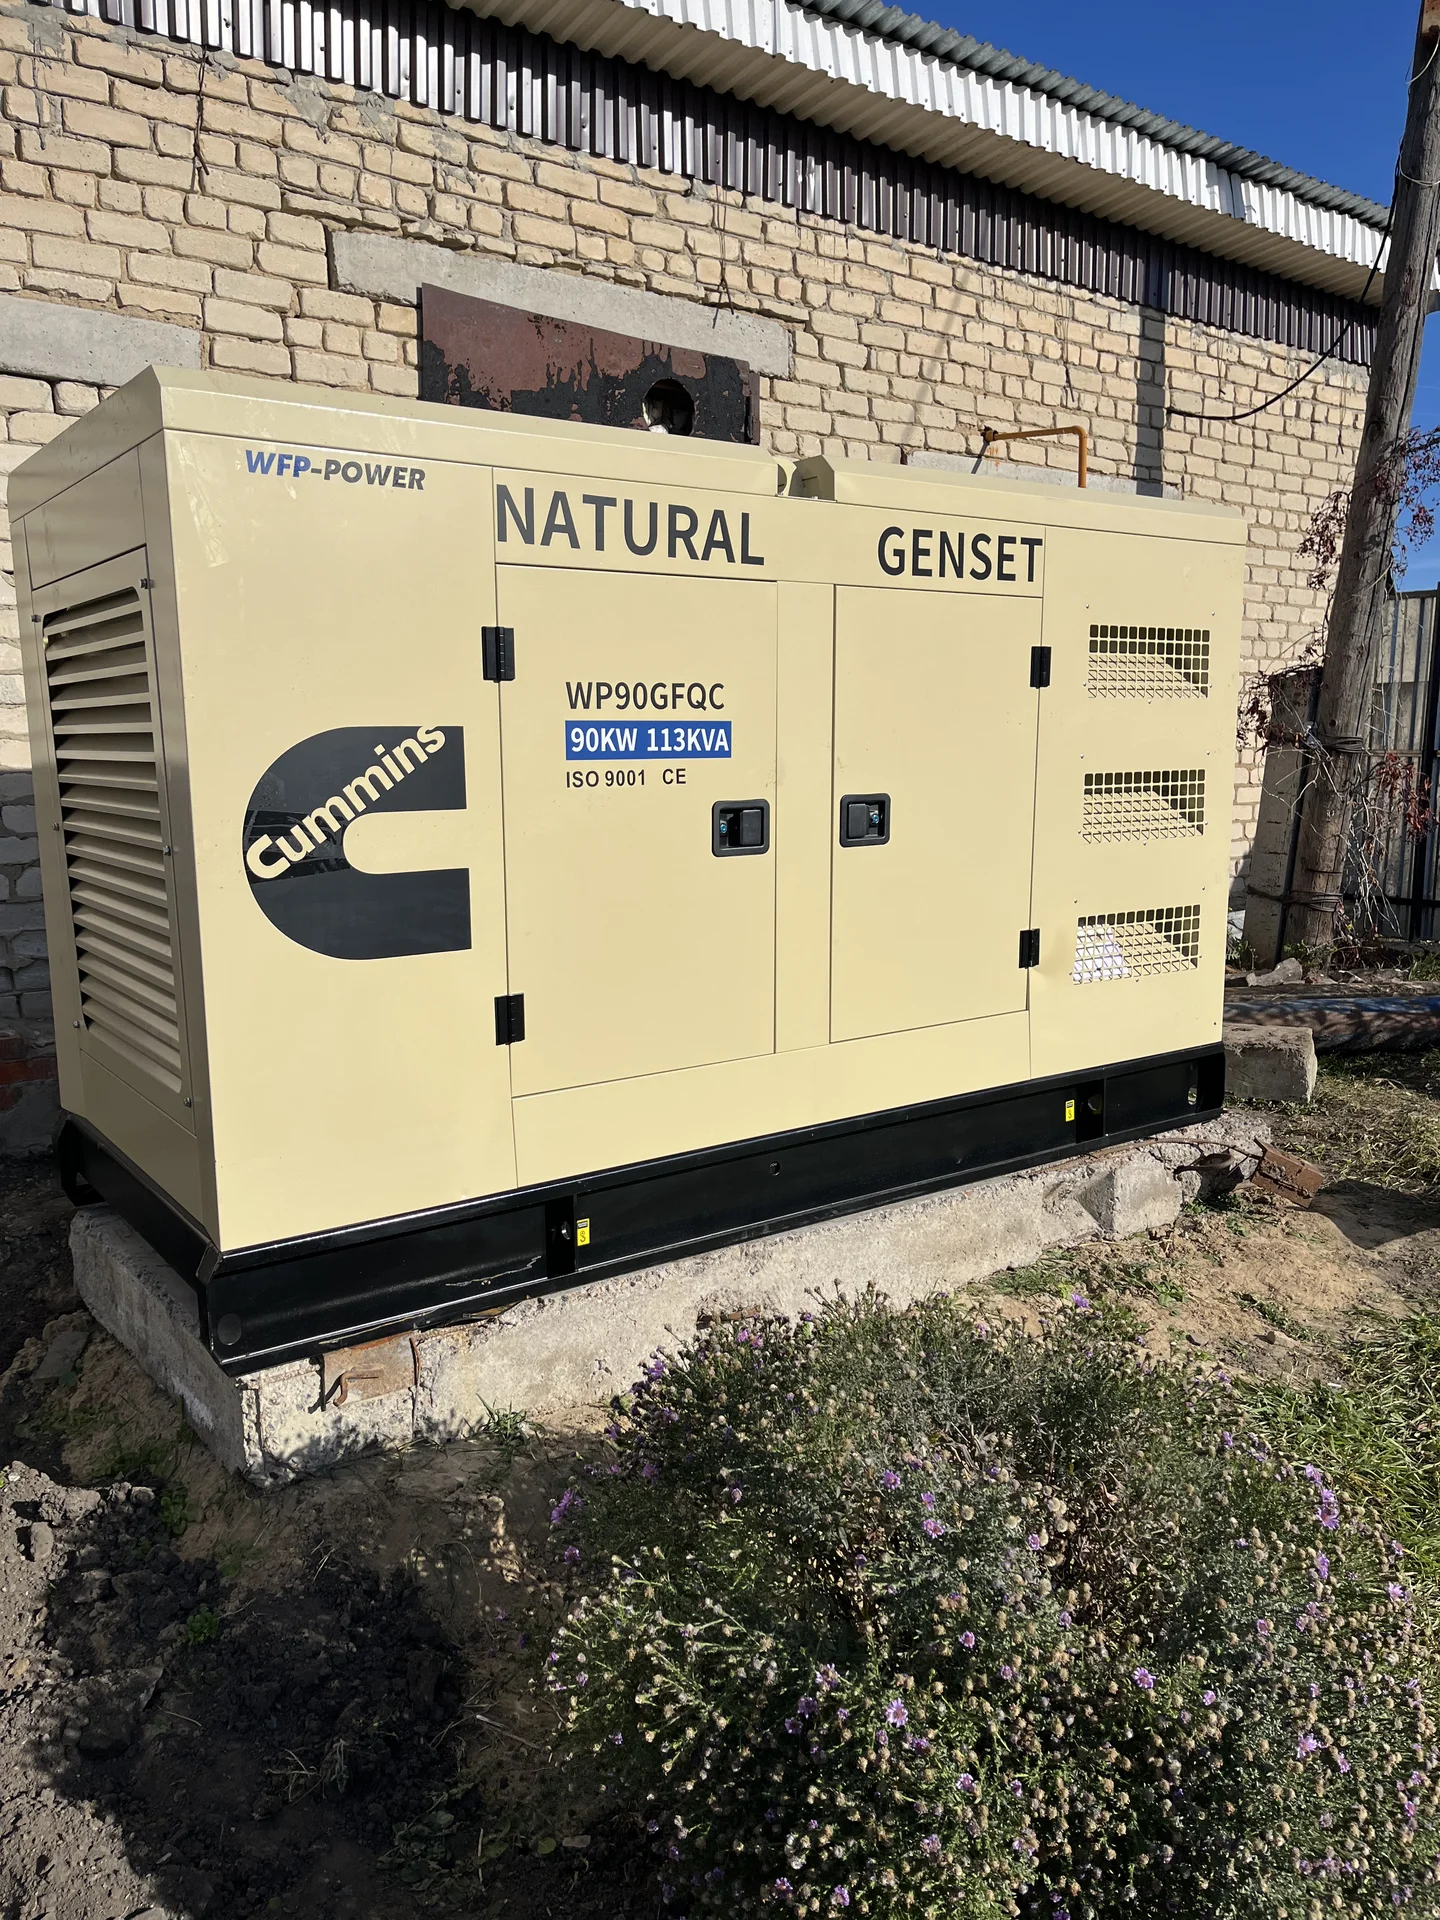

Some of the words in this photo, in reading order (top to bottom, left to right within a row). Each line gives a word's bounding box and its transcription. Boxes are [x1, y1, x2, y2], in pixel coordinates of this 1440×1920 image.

[245, 449, 426, 491] WFP-POWER
[496, 483, 765, 566] NATURAL
[877, 526, 1043, 583] GENSET
[565, 681, 725, 711] WP90GFQC
[570, 727, 638, 753] 90KW
[646, 727, 730, 752] 113KVA
[566, 770, 600, 788] ISO
[604, 769, 646, 787] 9001
[662, 768, 687, 785] CE
[246, 725, 446, 879] Cummins
